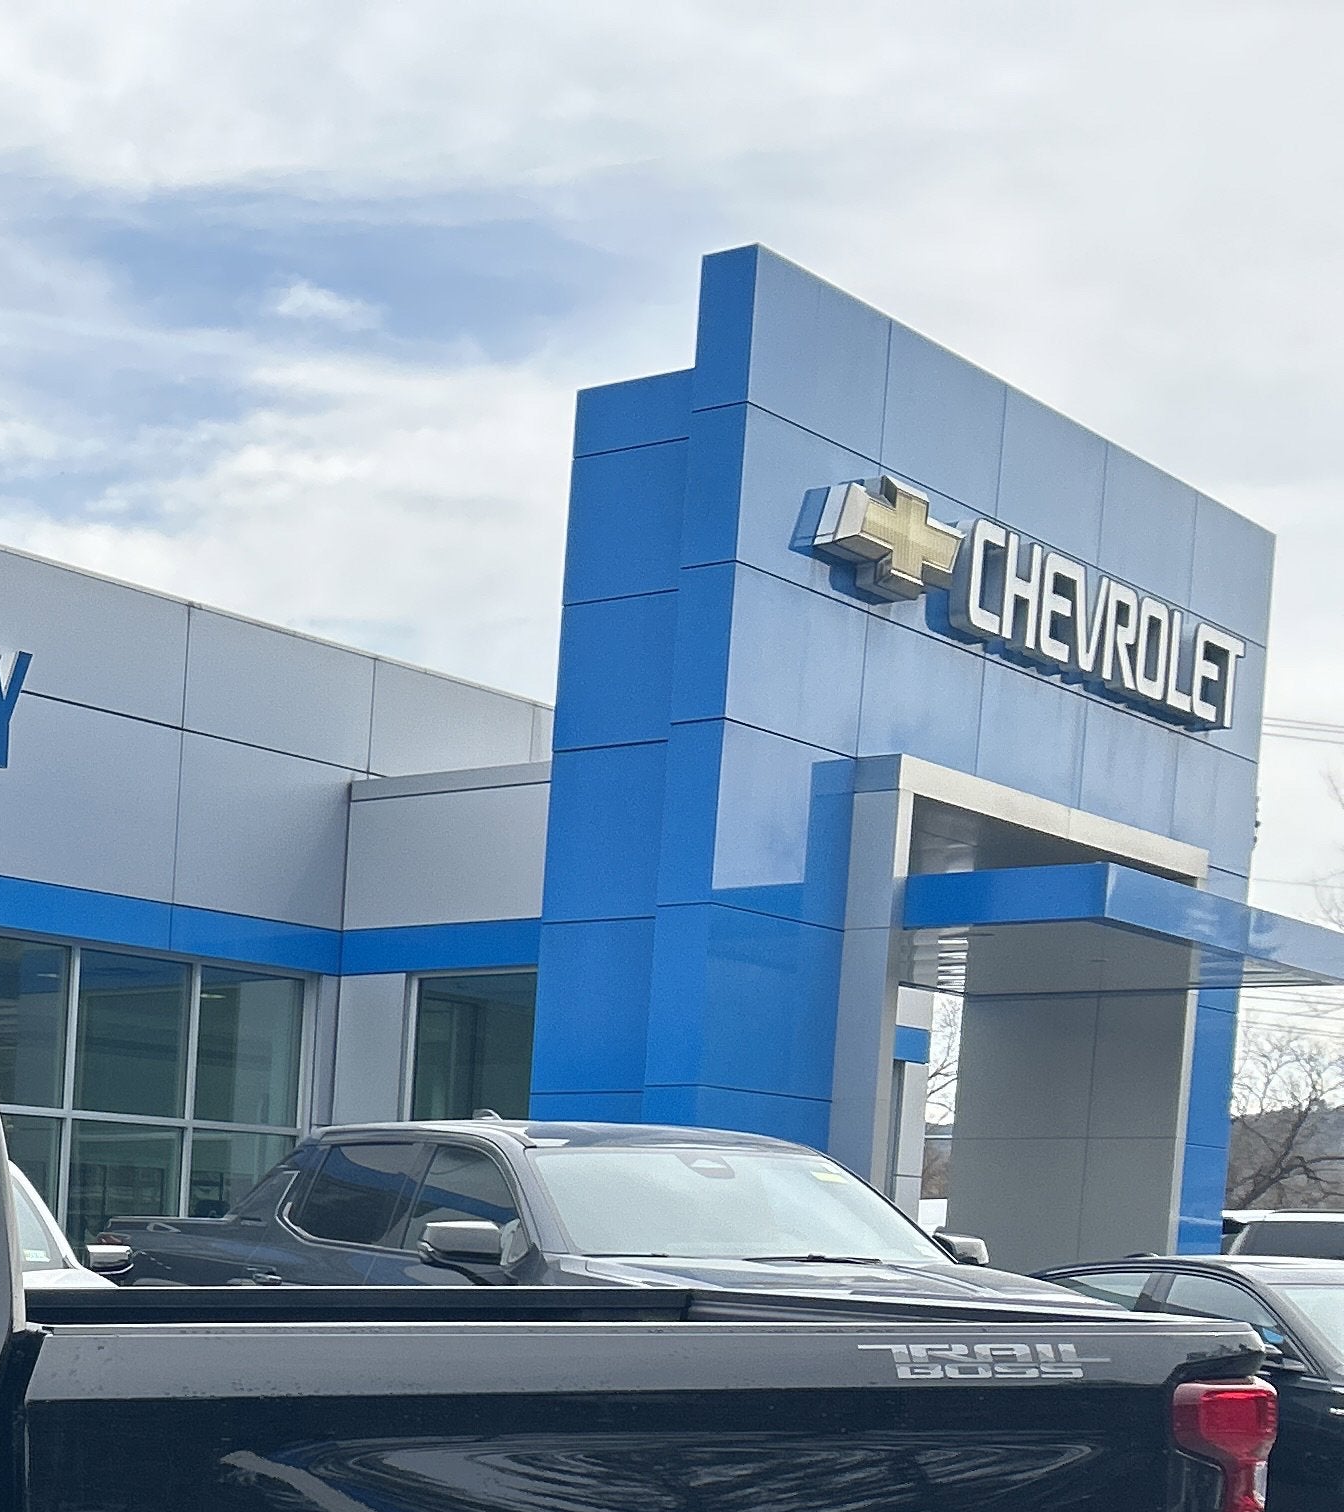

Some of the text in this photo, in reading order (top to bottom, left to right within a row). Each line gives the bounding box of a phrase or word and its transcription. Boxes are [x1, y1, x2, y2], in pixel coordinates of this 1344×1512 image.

[954, 517, 1247, 729] CHEVROLET
[857, 1343, 1111, 1363] TRAIL
[895, 1362, 1085, 1380] BOSS
